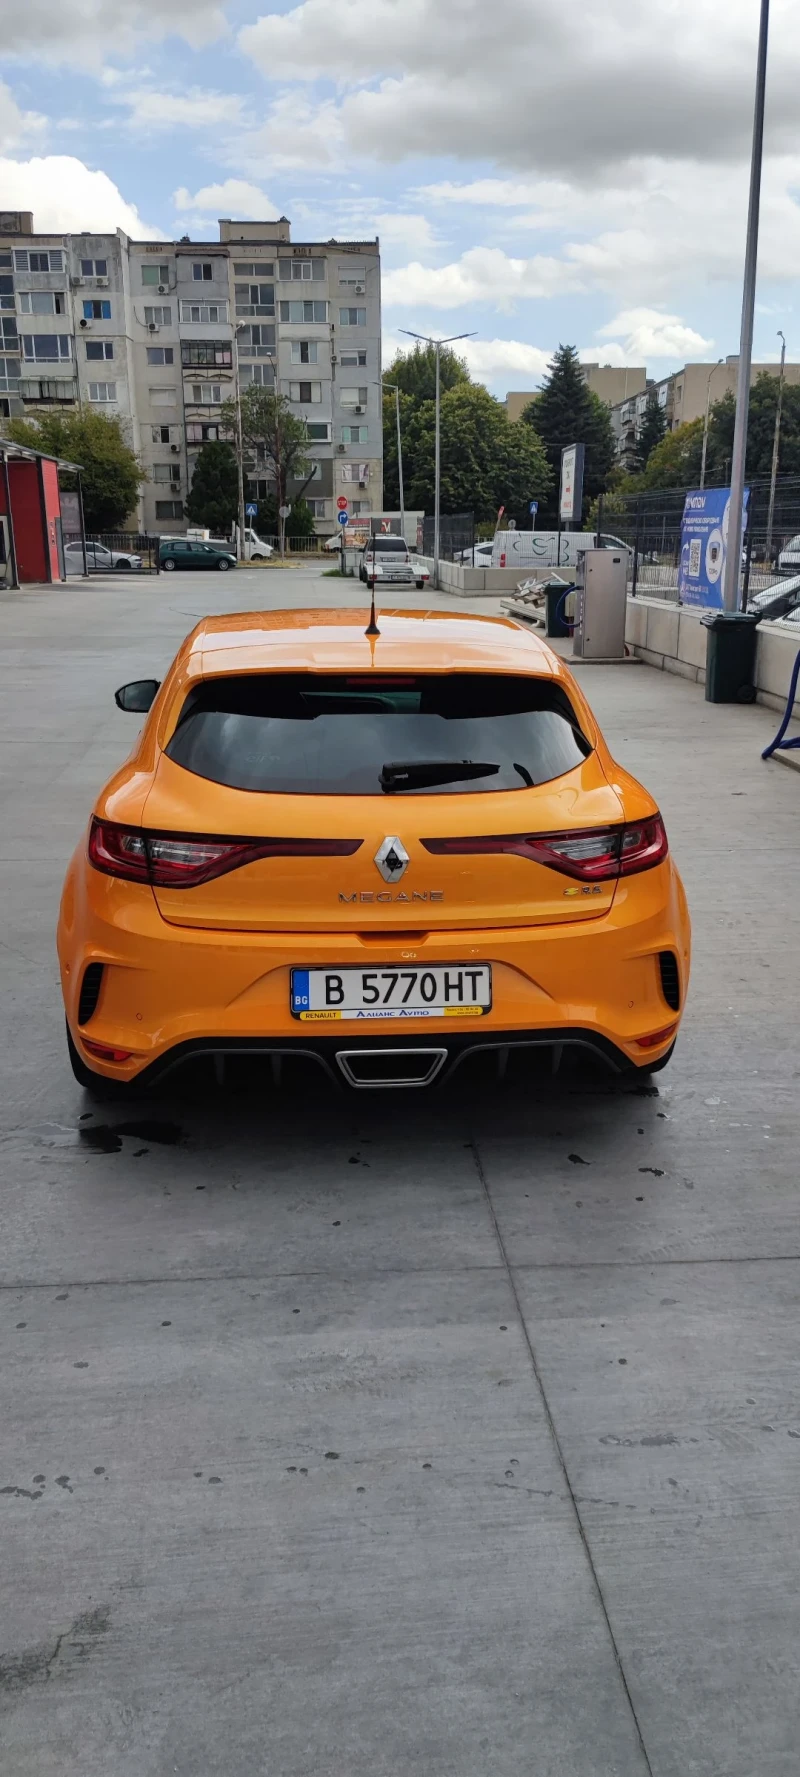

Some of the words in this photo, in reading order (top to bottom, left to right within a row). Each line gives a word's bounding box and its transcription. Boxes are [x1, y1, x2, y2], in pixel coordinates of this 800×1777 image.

[338, 890, 444, 903] MEGANE
[324, 975, 345, 1005] B
[294, 996, 308, 1005] BG
